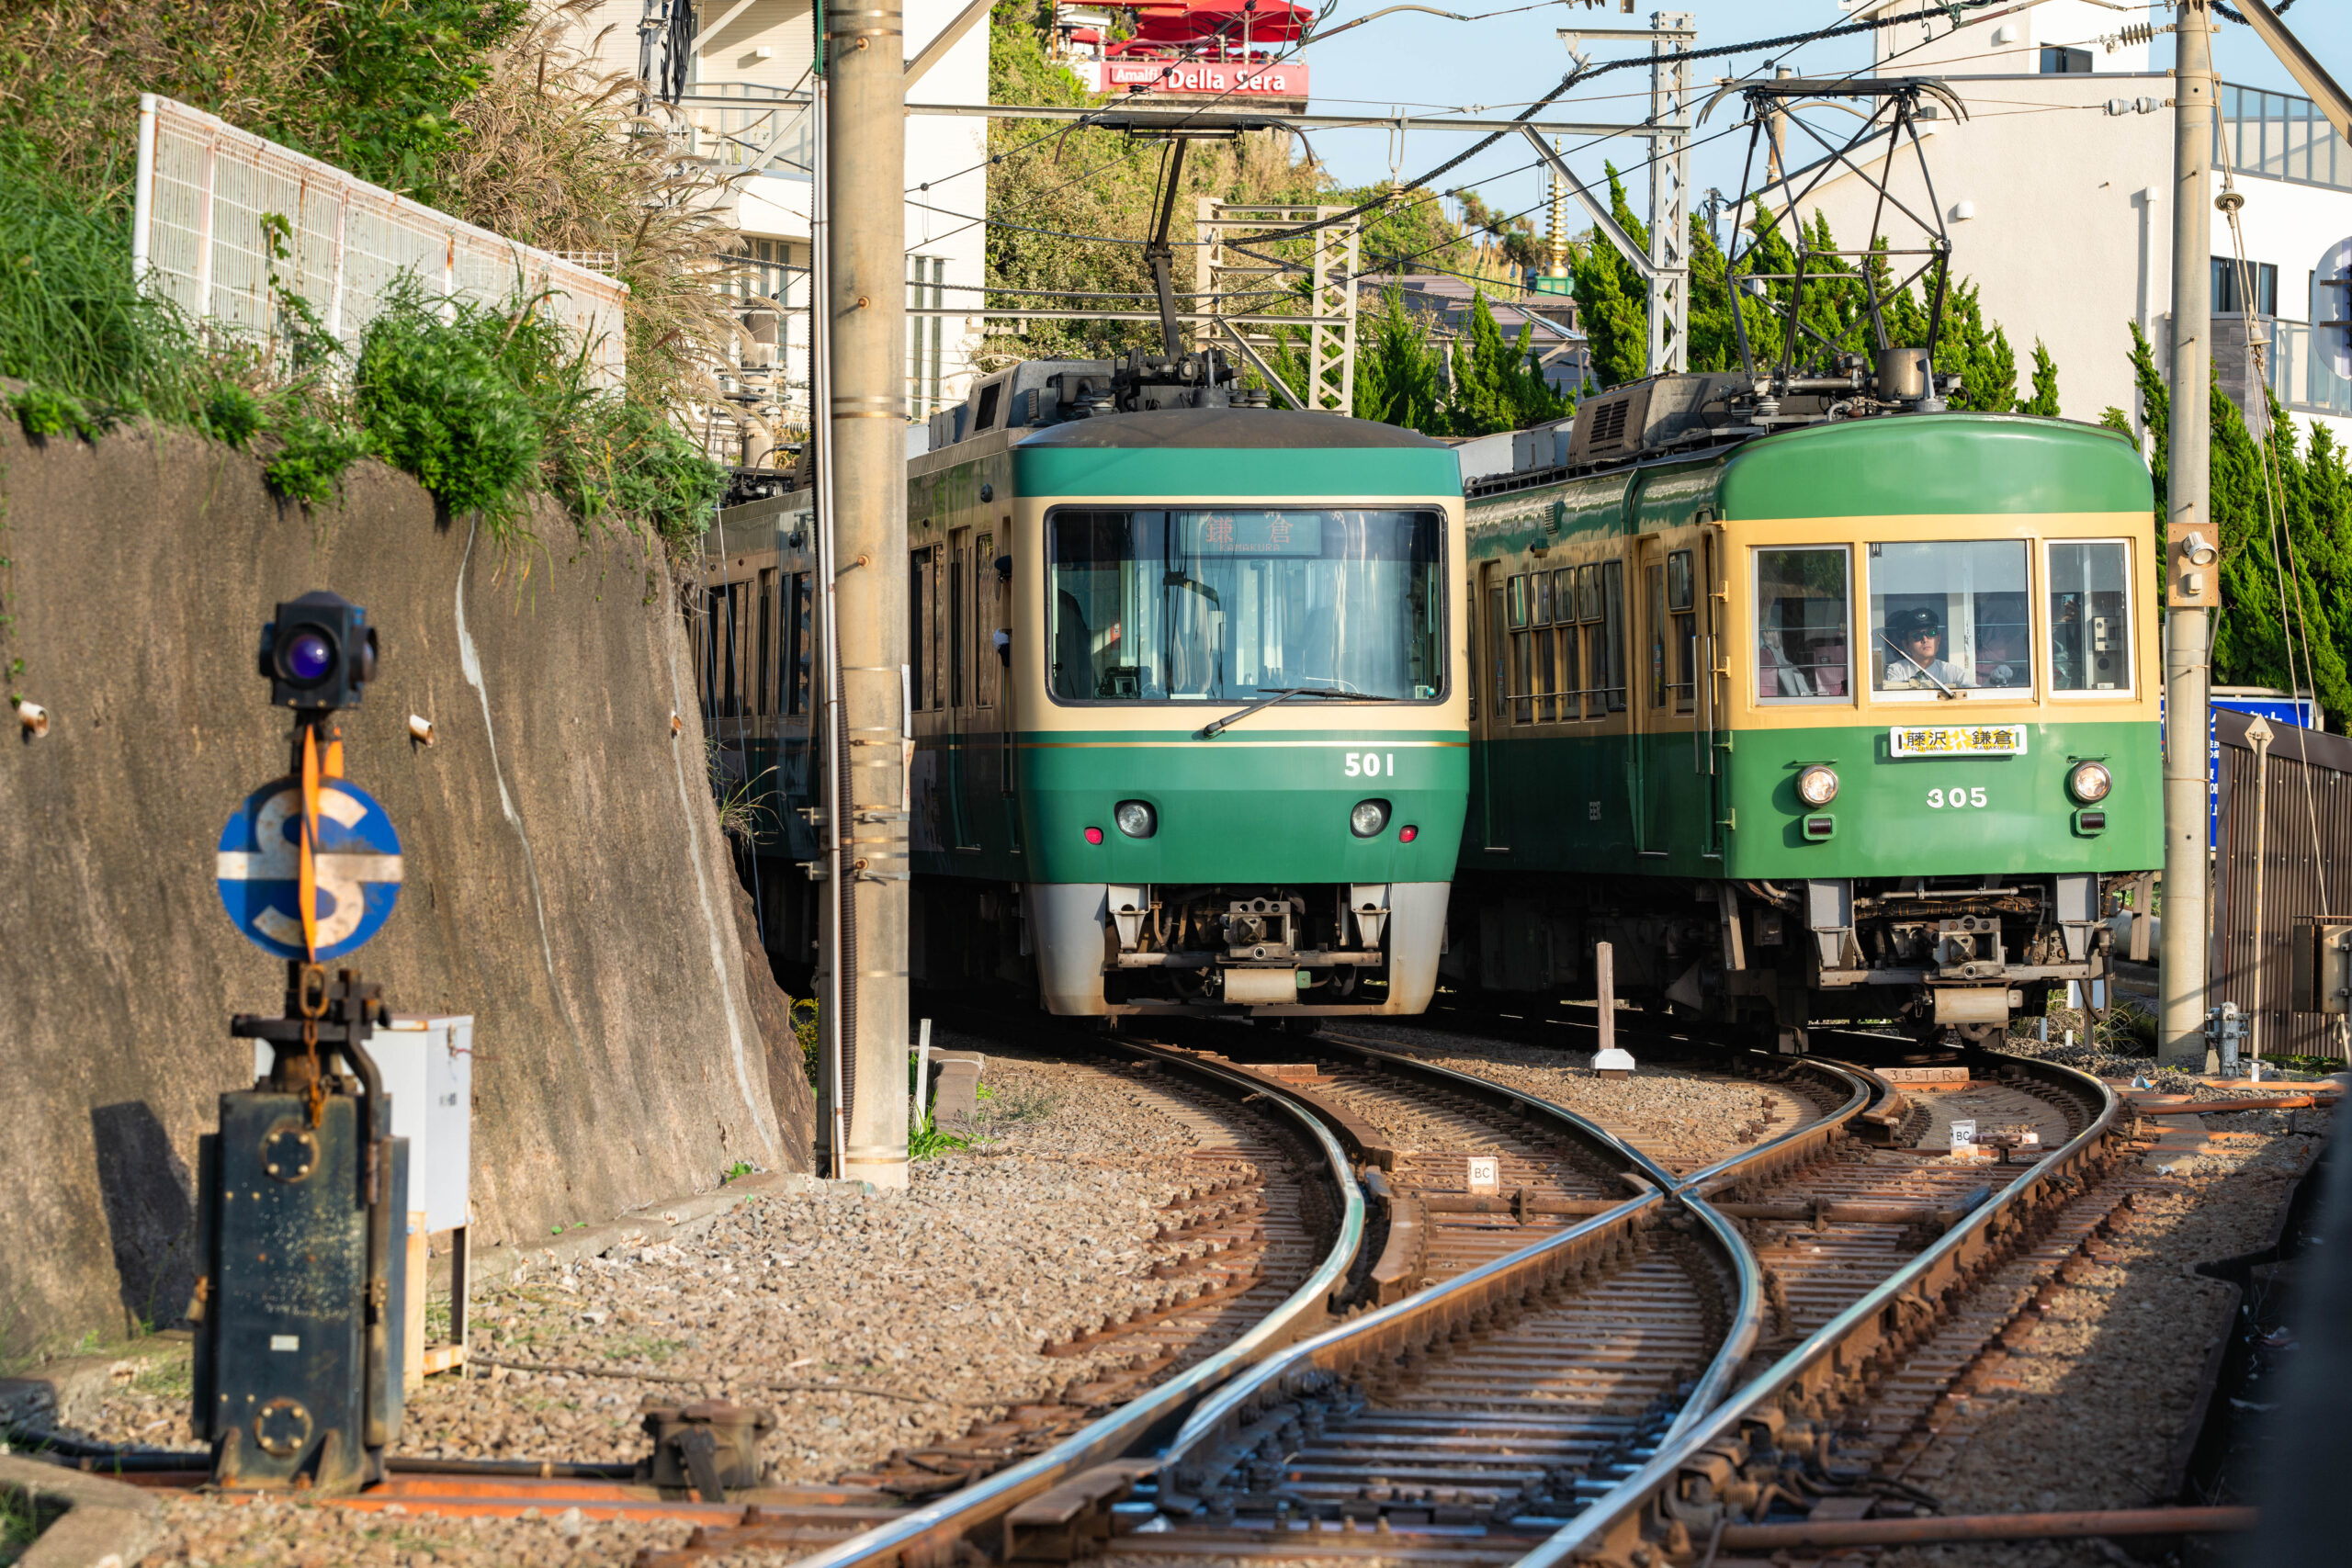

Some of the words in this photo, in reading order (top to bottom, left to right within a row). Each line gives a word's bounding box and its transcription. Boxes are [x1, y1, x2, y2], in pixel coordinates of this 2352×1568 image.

[1115, 68, 1158, 83] Amalfi
[1168, 68, 1225, 90] Della
[1236, 70, 1285, 91] Sera
[1205, 515, 1294, 543] 鎌倉
[1219, 544, 1280, 552] KAMAKURA
[1906, 731, 1946, 746] 藤沢
[1972, 730, 2012, 745] 鎌倉
[1345, 752, 1393, 776] 501
[1927, 787, 1986, 808] 305
[1956, 1131, 1970, 1141] BC
[1475, 1168, 1490, 1178] BC
